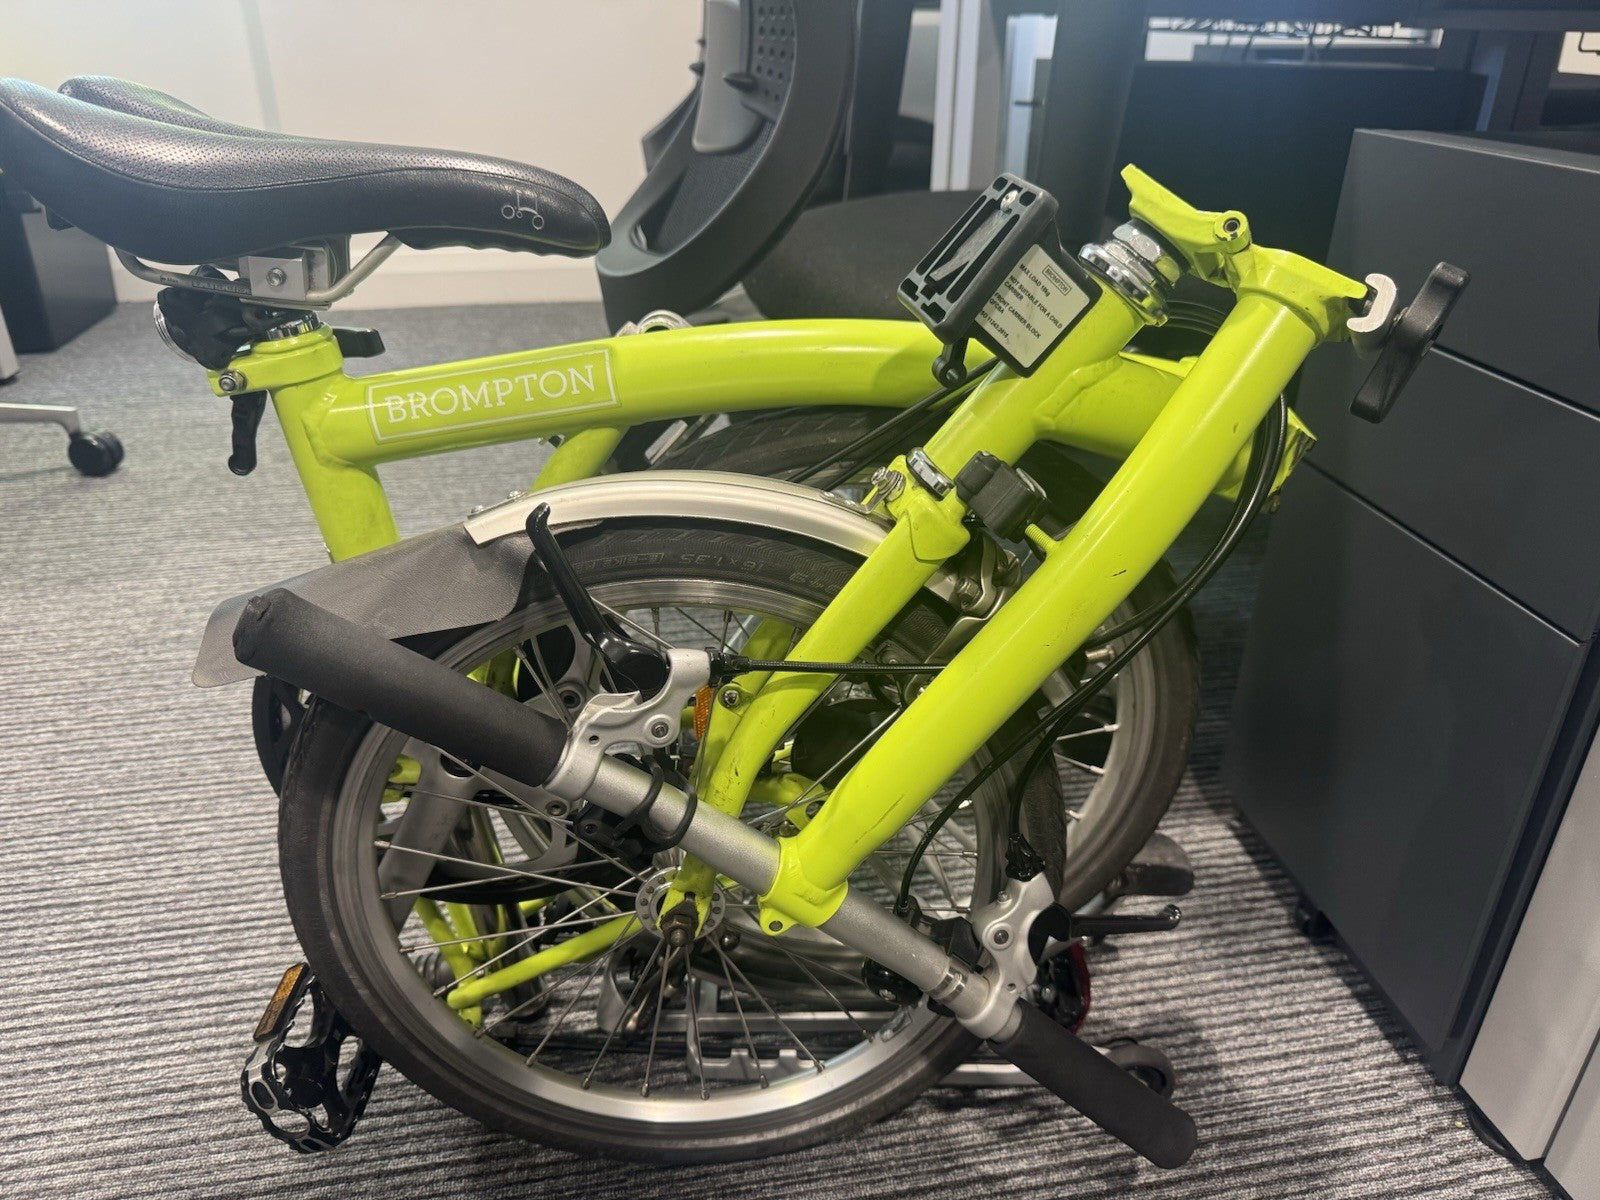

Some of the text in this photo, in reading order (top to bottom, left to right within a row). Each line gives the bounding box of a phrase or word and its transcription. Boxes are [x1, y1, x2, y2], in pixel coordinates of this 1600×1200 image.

[1004, 281, 1024, 300] CARRIER
[1020, 264, 1031, 275] MAX
[1029, 274, 1041, 287] LOAD
[1045, 268, 1068, 292] BROMPTON
[995, 292, 1041, 339] FRONT CARRIER BLOCK
[1010, 275, 1019, 285] NOT
[1019, 284, 1039, 306] SUITABLE
[1037, 304, 1047, 314] FOR
[1049, 315, 1062, 329] CHILD
[385, 365, 595, 423] BROMPTON
